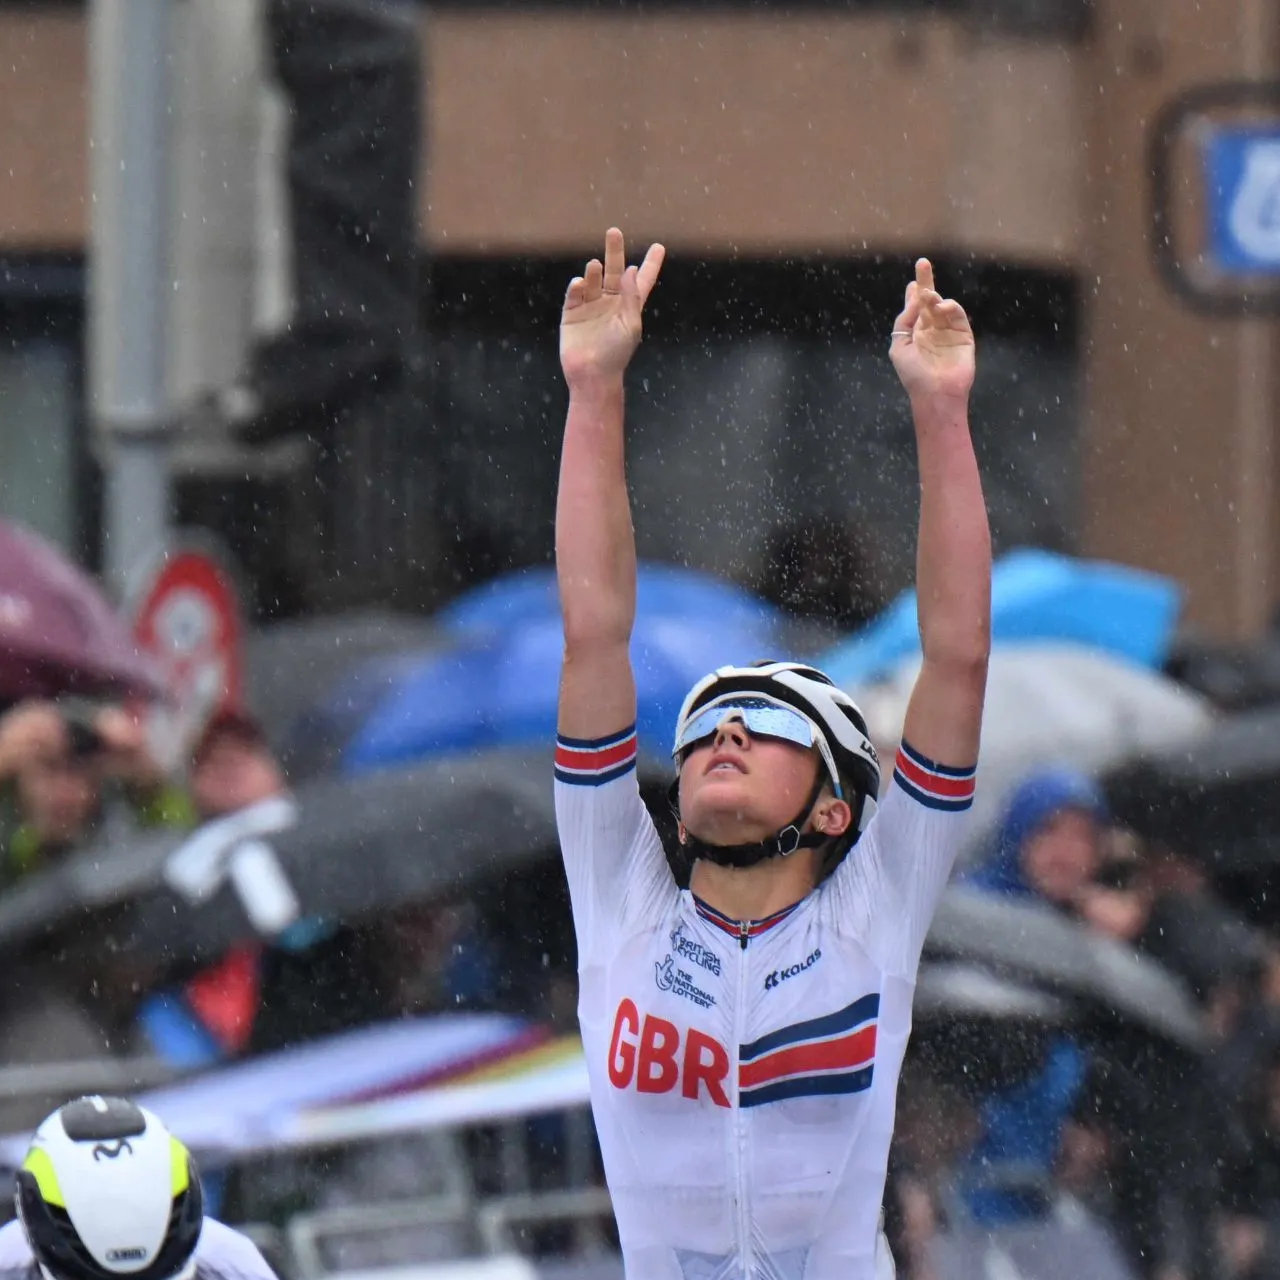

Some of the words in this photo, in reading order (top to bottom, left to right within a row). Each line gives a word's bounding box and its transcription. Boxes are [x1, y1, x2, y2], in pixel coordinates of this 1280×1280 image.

[677, 949, 721, 977] CYCLING
[679, 936, 721, 966] BRITISH
[676, 968, 693, 983] THE
[671, 987, 713, 1010] LOTTERY
[674, 976, 718, 1005] NATIONAL
[608, 998, 731, 1108] GBR
